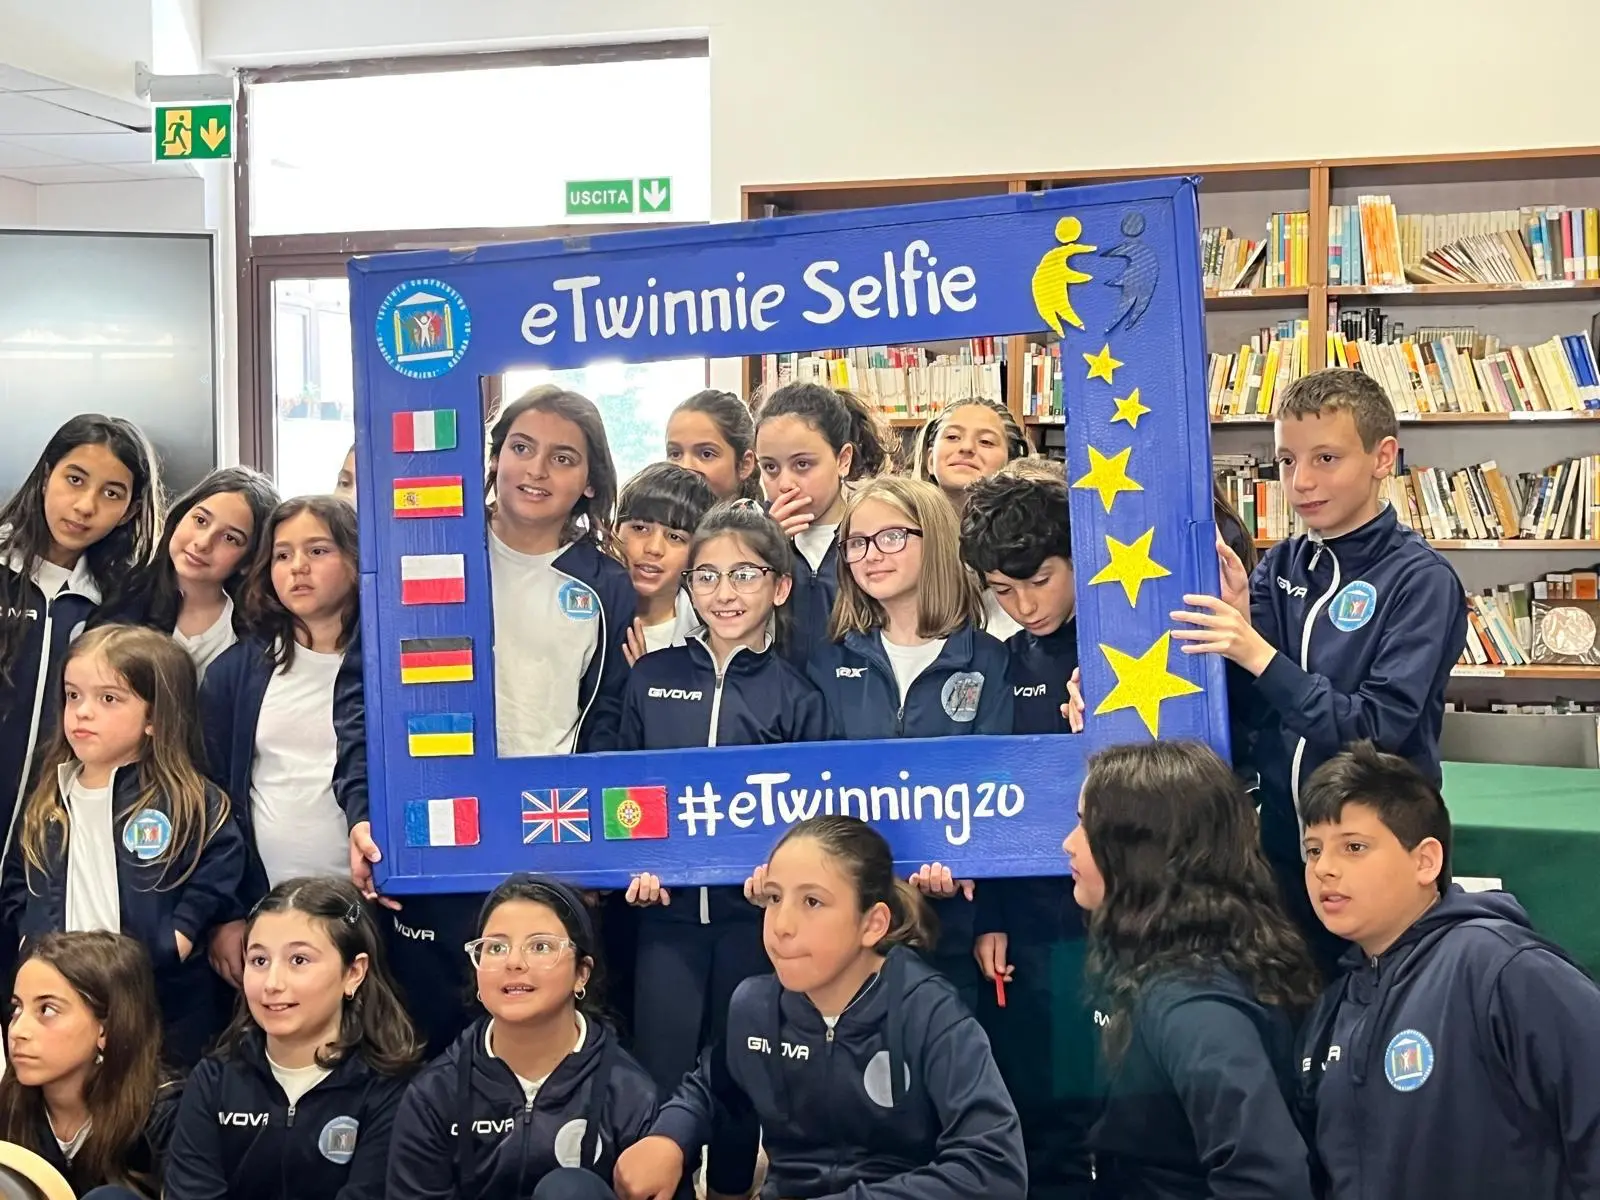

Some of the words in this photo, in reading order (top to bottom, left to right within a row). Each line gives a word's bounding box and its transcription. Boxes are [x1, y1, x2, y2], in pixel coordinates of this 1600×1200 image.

[570, 190, 629, 206] USCITA
[520, 271, 786, 346] eTwinnie
[801, 239, 977, 325] Selfie
[647, 687, 703, 701] GIVOVA
[1013, 683, 1047, 698] VOVA
[677, 770, 1026, 846] #eTwinning20
